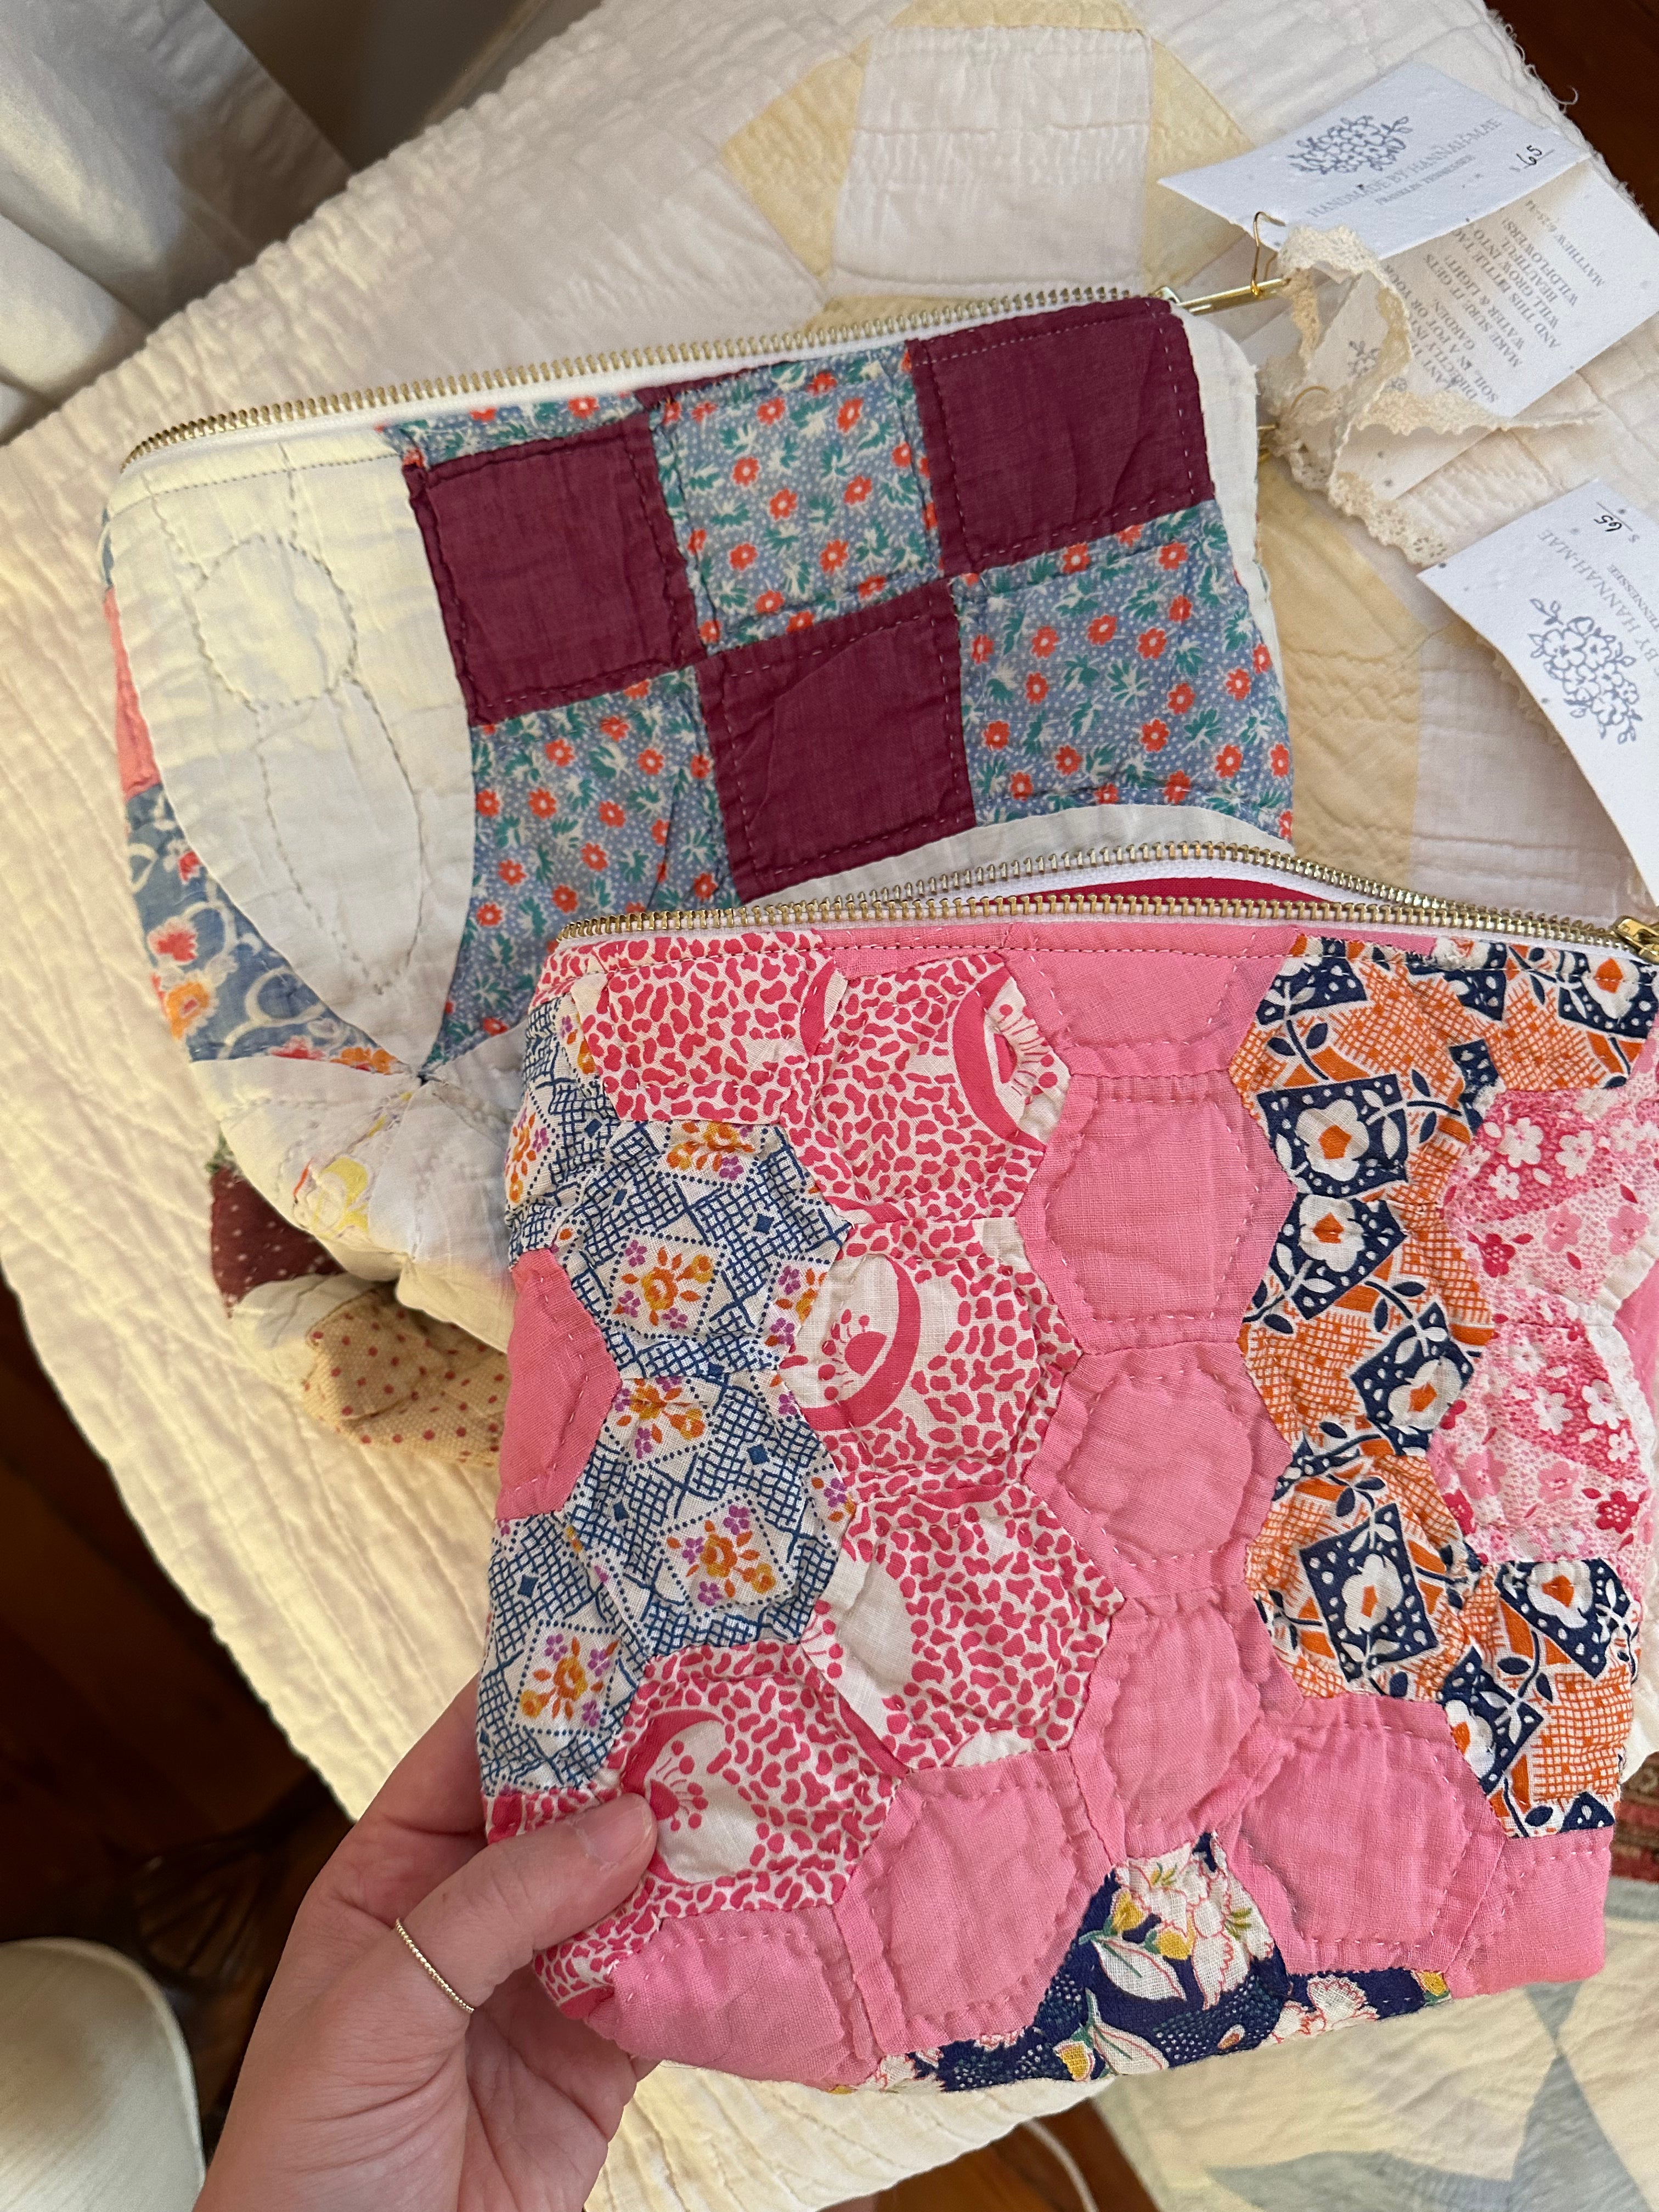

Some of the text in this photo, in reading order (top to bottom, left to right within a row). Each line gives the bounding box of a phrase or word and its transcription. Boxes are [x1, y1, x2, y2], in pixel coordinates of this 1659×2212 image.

[1515, 144, 1542, 165] 65
[1386, 168, 1408, 183] BY
[1472, 251, 1510, 292] LITTLE
[1500, 238, 1556, 302] BEAUTIFUL
[1554, 232, 1606, 288] MATTHEW
[1383, 265, 1411, 297] YOUR
[1474, 229, 1559, 328] WILL GROW INTO
[1410, 298, 1429, 318] OR
[1424, 254, 1521, 367] MAKE SURE IT GETS
[1477, 295, 1490, 307] &
[1509, 294, 1534, 322] THIS
[1427, 320, 1449, 343] POT
[1488, 307, 1525, 349] WATER
[1533, 323, 1559, 349] AND
[1448, 344, 1460, 356] A
[1593, 515, 1622, 532] 65
[1537, 529, 1658, 662] BY HANNAH-MAE
